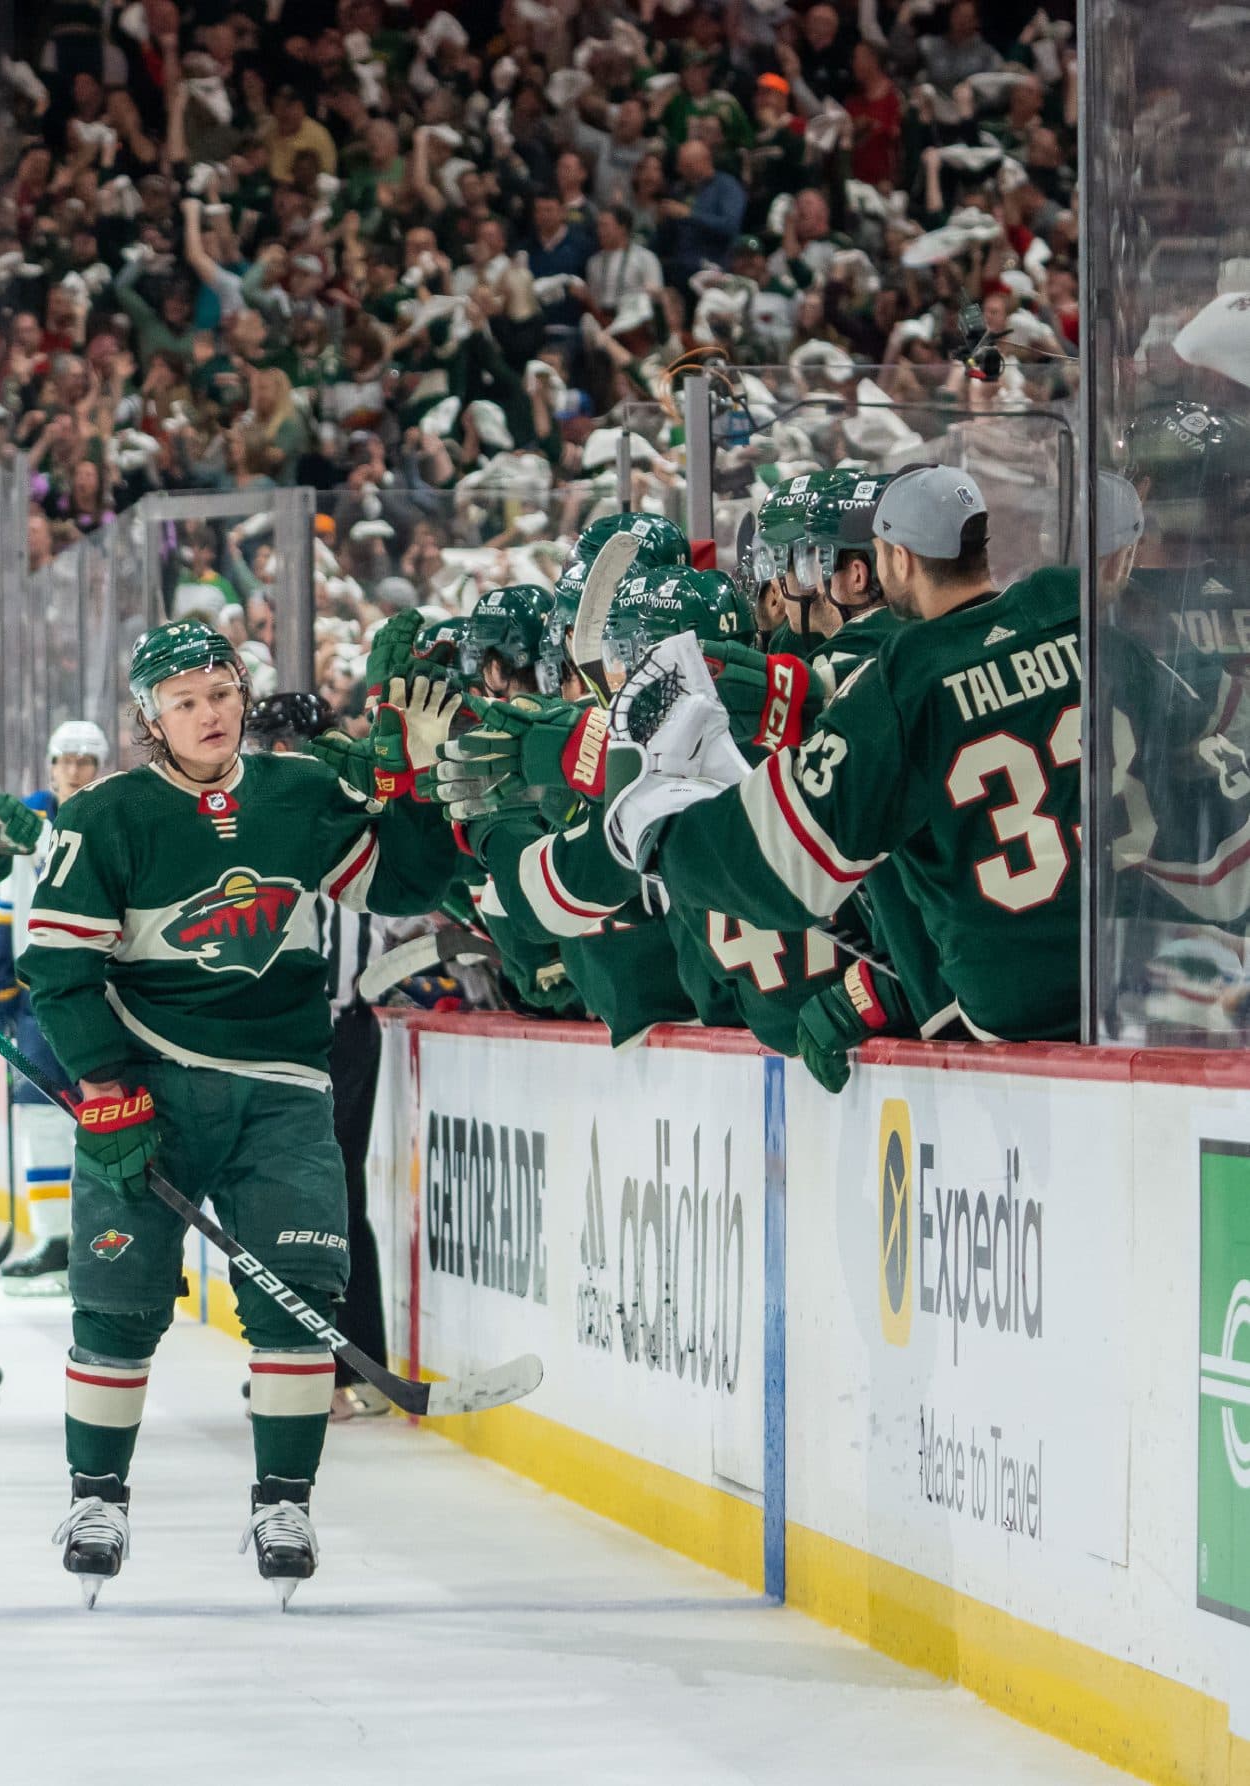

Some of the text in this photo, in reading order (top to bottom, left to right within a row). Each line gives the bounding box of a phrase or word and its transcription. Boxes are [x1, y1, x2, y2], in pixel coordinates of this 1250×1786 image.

[1162, 415, 1206, 453] TOYOTA
[776, 491, 820, 507] TOYOTA
[478, 606, 507, 616] TOYOTA
[619, 593, 650, 608] TOYOT
[651, 598, 682, 610] TOYOTA
[718, 612, 738, 633] 47
[942, 633, 1082, 721] TALBOT
[81, 1093, 155, 1125] BAUE
[426, 1110, 548, 1306] GATORADE
[276, 1230, 348, 1252] BAUER
[617, 1118, 745, 1396] adiclub
[919, 1142, 1043, 1367] Expedia
[231, 1252, 350, 1352] BAUER
[918, 1403, 1043, 1542] Made to Travel
